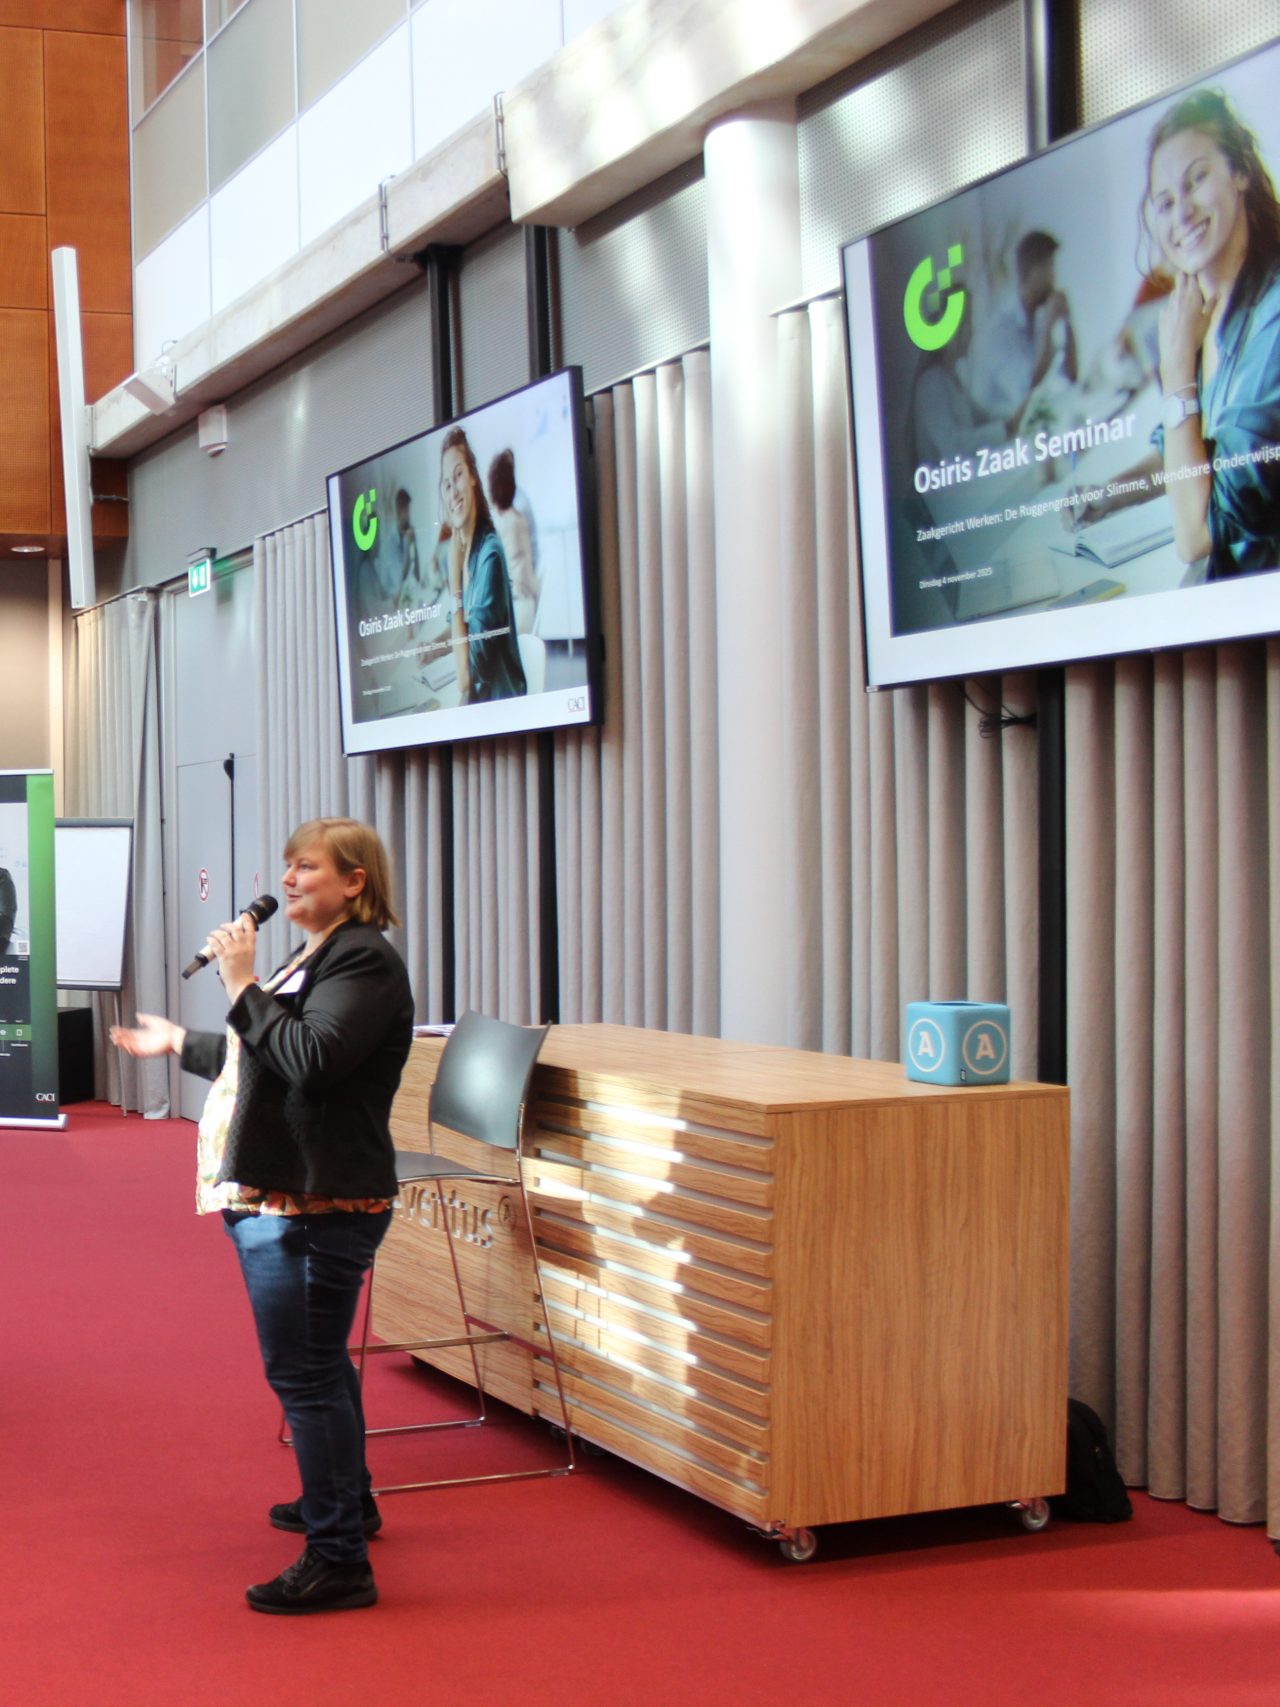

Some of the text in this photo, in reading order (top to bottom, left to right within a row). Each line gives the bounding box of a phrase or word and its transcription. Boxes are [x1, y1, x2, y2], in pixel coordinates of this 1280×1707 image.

[914, 414, 1136, 493] Osiris Zaak Seminar
[916, 521, 966, 542] Zaakgericht
[966, 512, 1004, 530] Werken:
[1004, 508, 1018, 521] De
[1020, 493, 1080, 517] Ruggengraat
[1081, 487, 1104, 503] voor
[1106, 479, 1150, 498] Slimme,
[1151, 463, 1211, 486] Wendbare
[359, 603, 442, 637] Osiris Zaak Seminar
[917, 1031, 935, 1058] A
[975, 1033, 996, 1060] A
